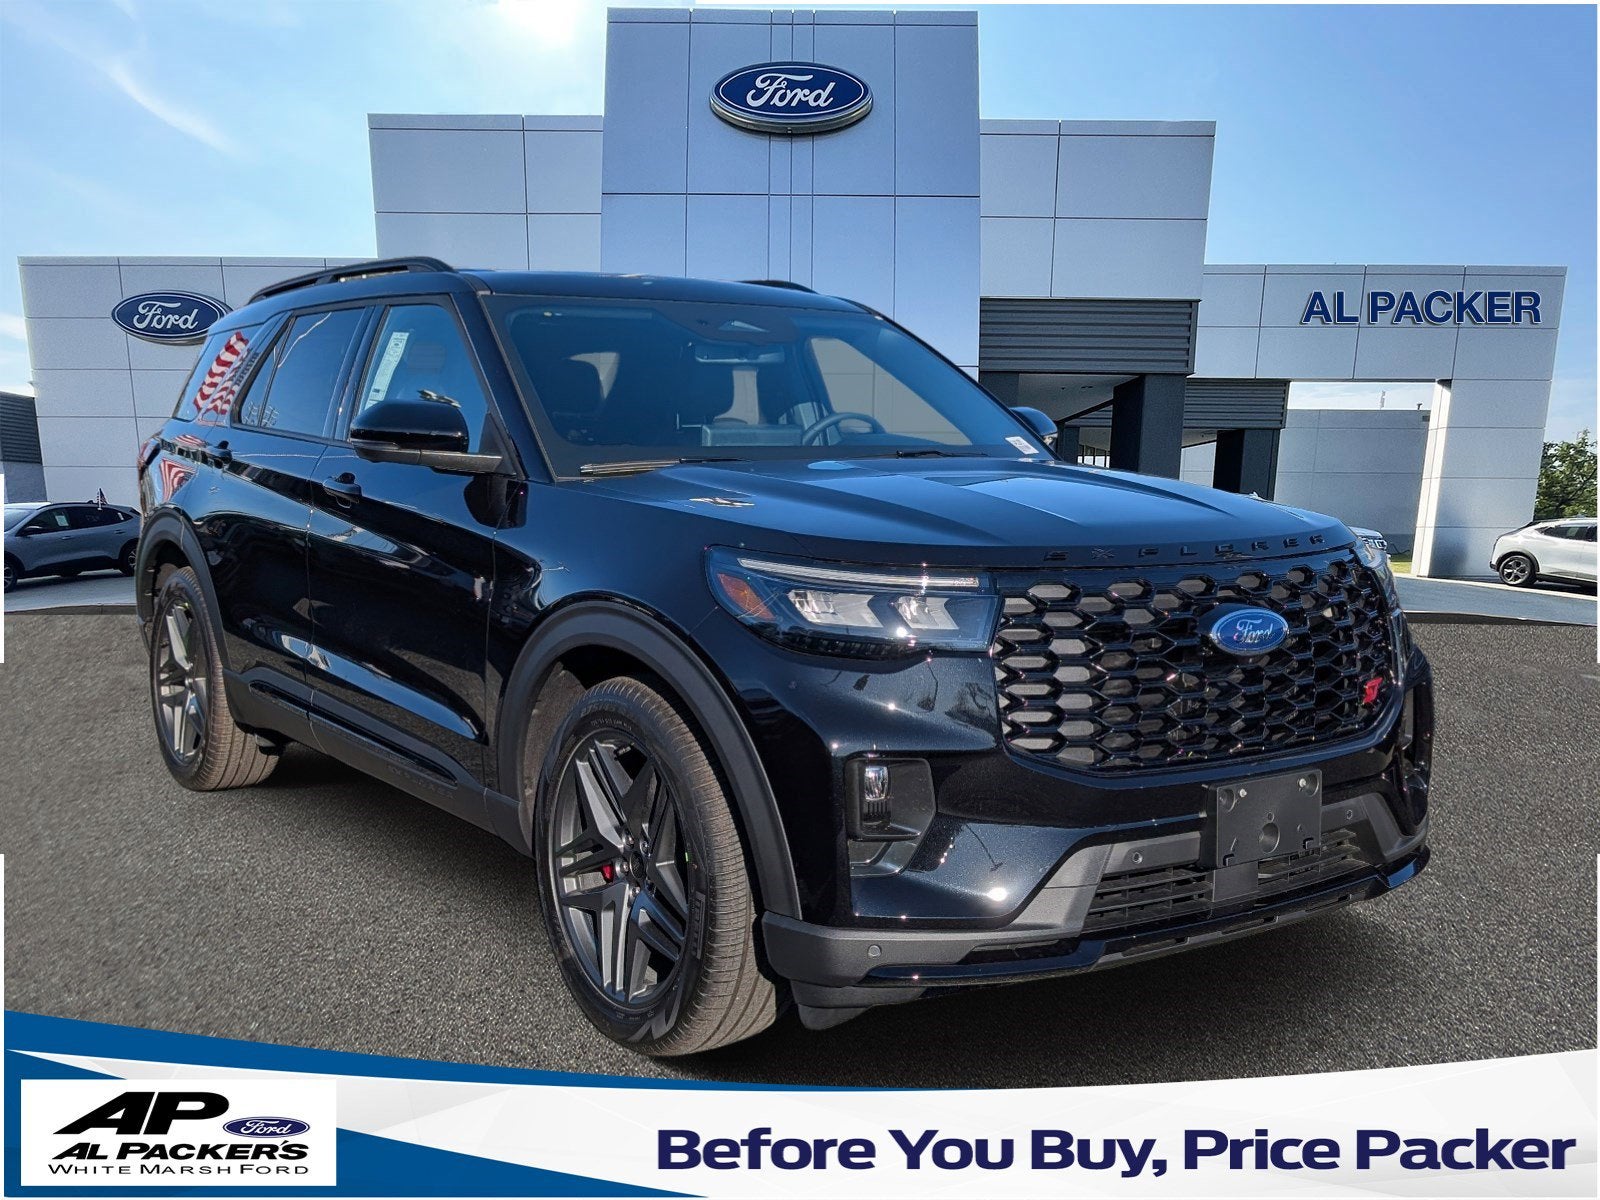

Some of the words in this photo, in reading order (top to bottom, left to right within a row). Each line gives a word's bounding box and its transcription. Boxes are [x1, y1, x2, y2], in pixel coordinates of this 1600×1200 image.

[746, 73, 836, 107] Ford
[133, 301, 199, 329] Ford
[1302, 291, 1359, 324] AL
[1369, 290, 1542, 325] PACKER
[1044, 534, 1325, 561] EXPLORER
[1233, 618, 1275, 643] Ford
